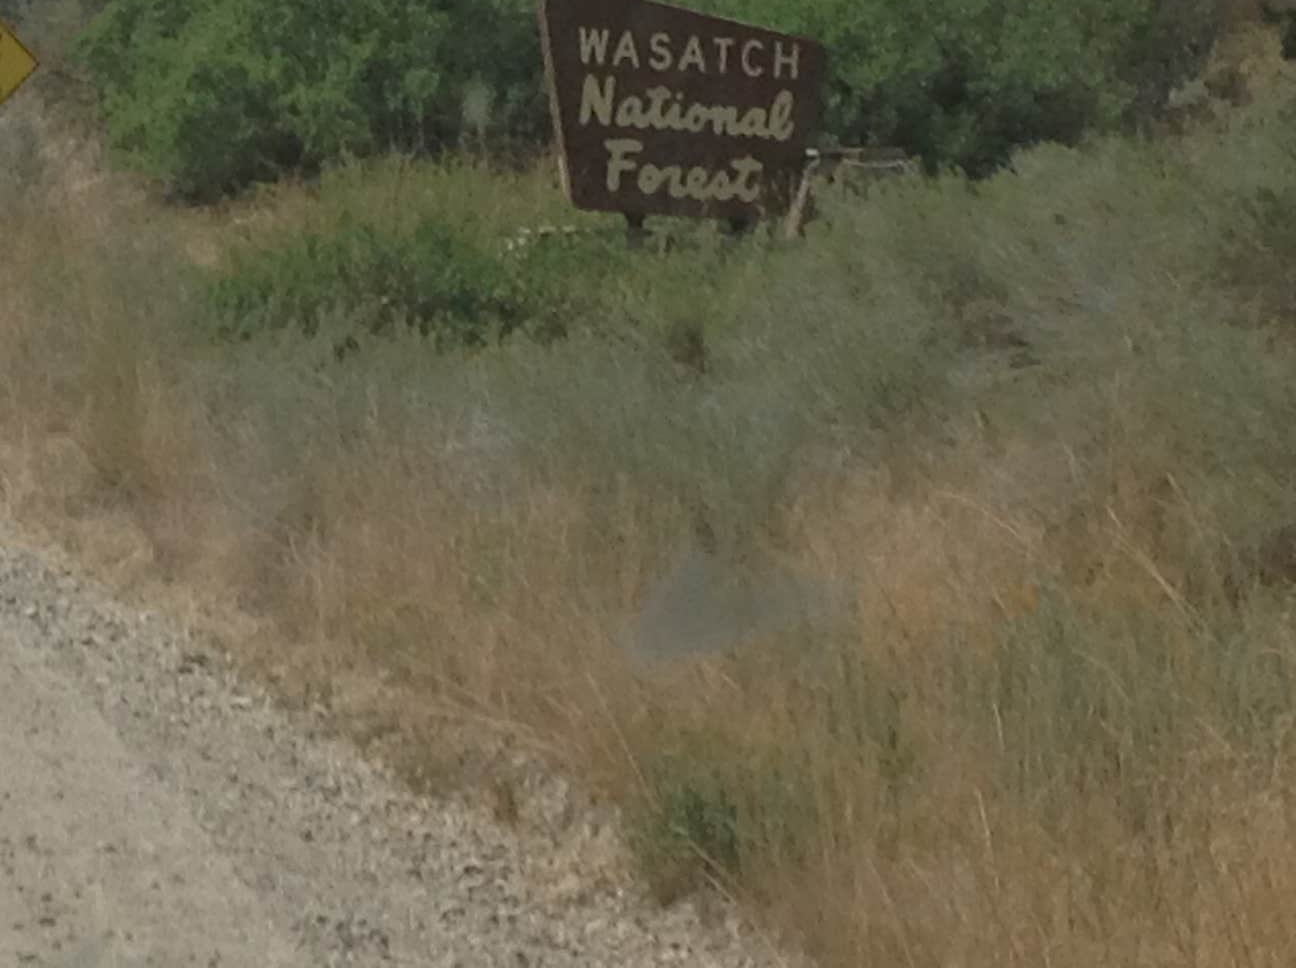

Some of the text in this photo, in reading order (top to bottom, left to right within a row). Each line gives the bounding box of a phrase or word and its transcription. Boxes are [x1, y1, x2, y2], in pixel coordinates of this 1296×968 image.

[579, 27, 799, 78] WASATCH
[579, 74, 794, 140] National
[605, 139, 762, 201] Forest
